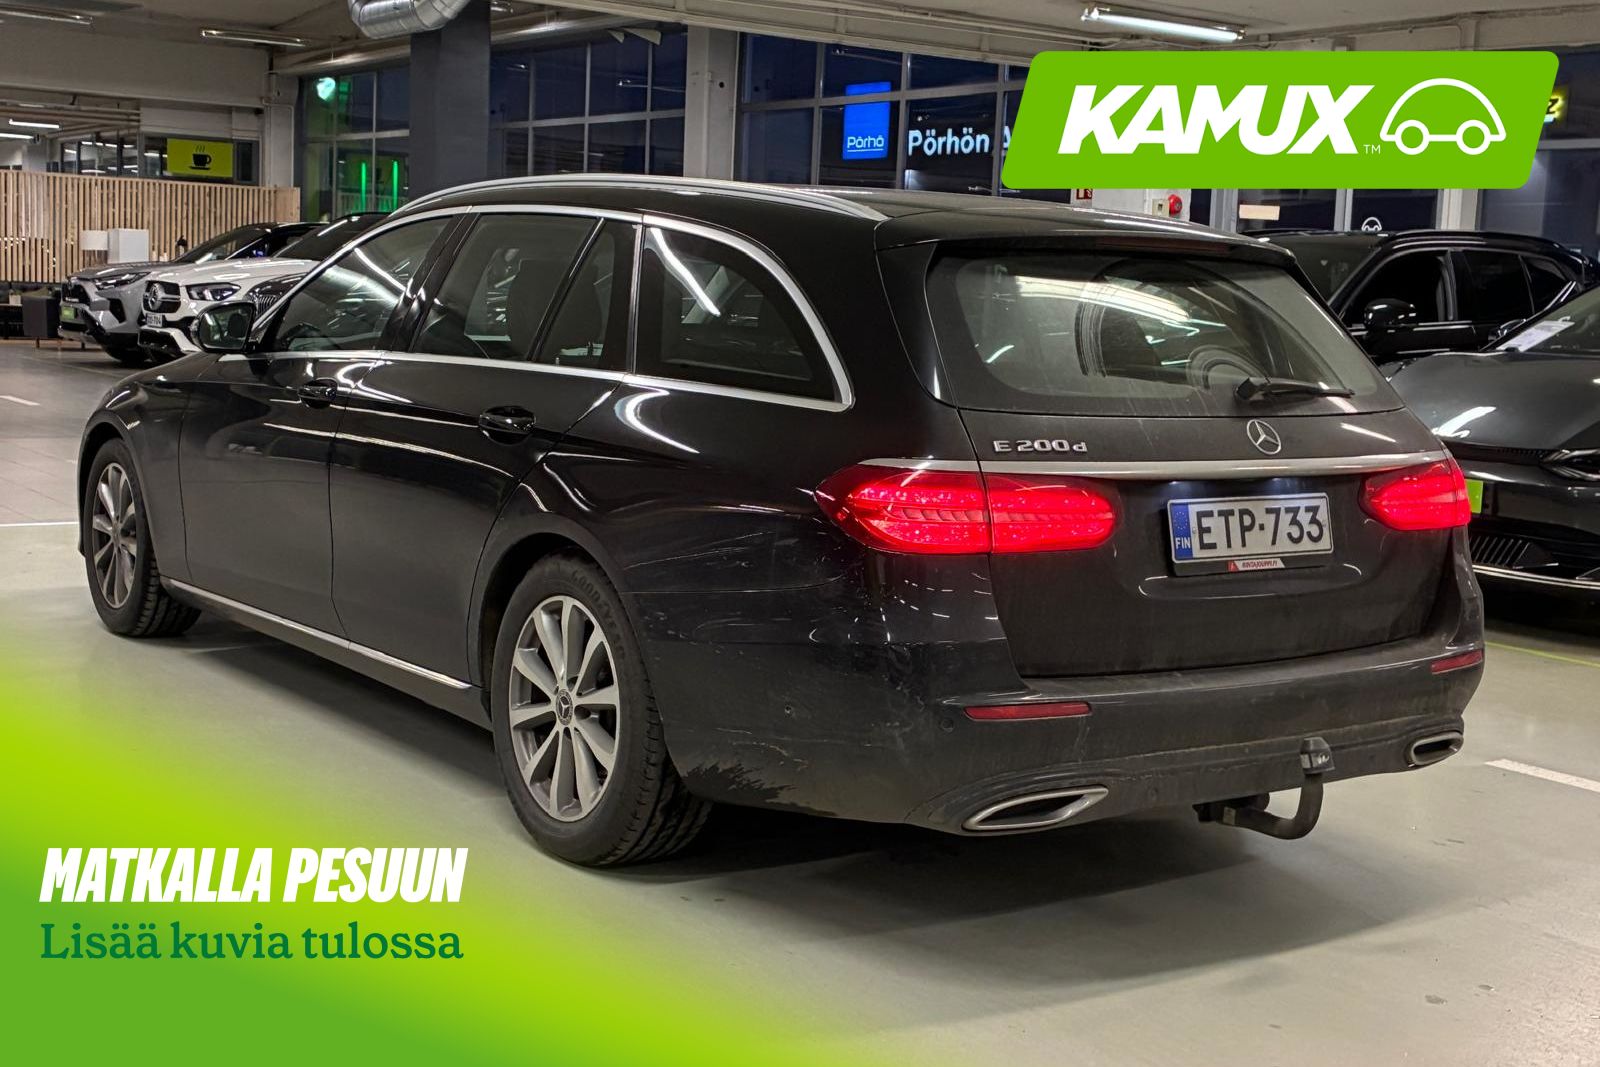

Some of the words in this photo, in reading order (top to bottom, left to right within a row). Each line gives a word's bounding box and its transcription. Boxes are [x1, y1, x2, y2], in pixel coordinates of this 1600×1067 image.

[847, 134, 885, 150] Pörhö
[908, 127, 990, 156] Pörhön
[993, 440, 1012, 452] E
[1196, 505, 1324, 550] ETP-733
[1175, 537, 1191, 551] FIN
